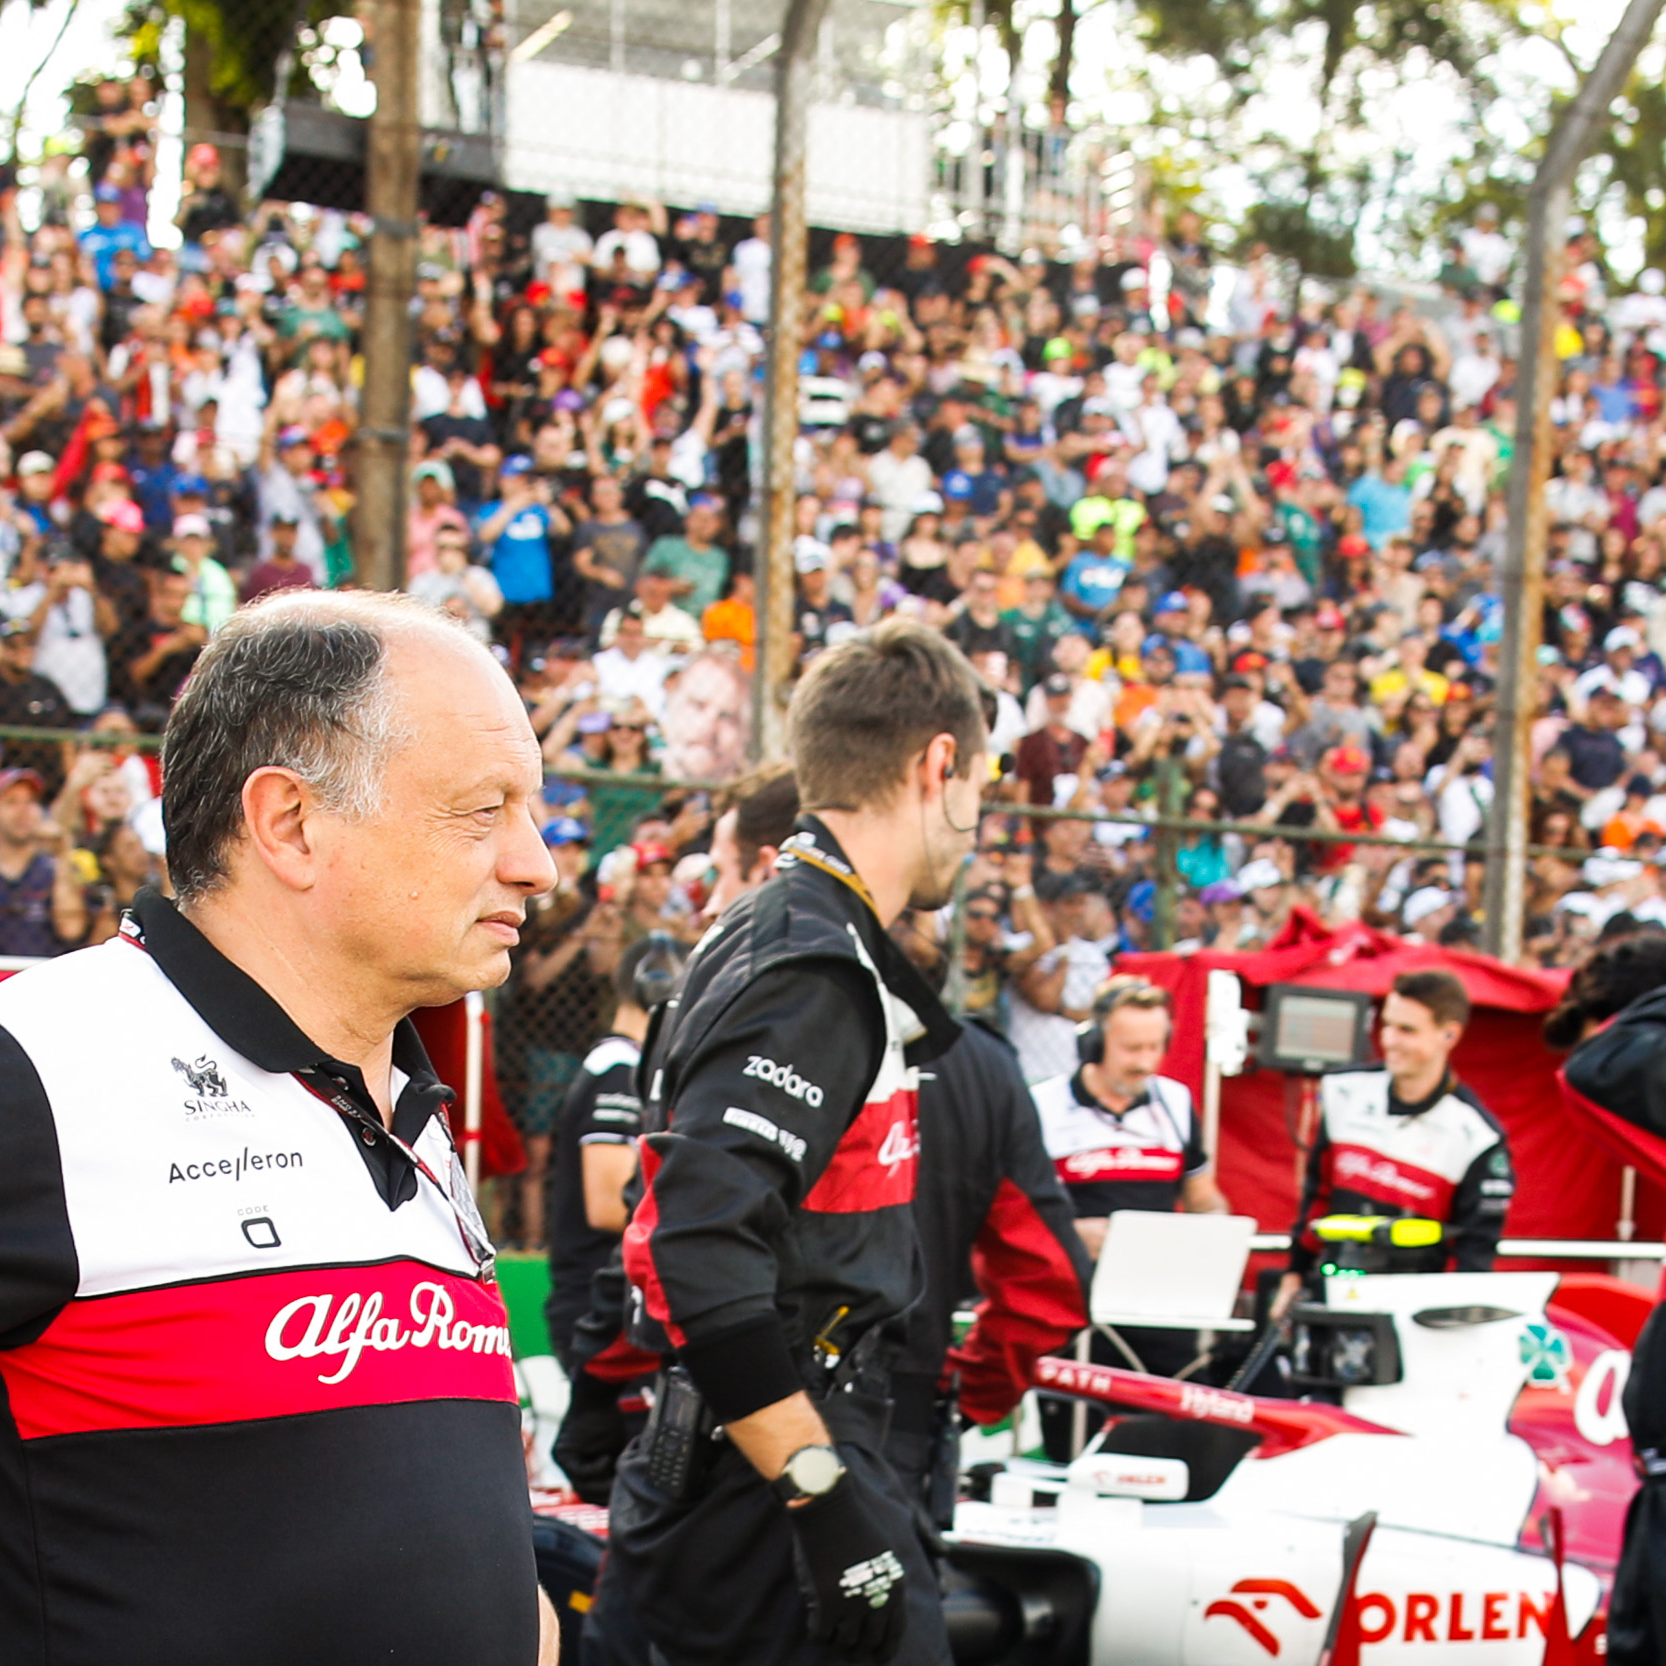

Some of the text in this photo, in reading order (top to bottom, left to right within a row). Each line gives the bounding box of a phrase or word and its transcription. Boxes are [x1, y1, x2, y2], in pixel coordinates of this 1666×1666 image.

[184, 1100, 252, 1116] SINGHA
[742, 1055, 824, 1108] zadara
[237, 1205, 270, 1217] CODE
[264, 1291, 410, 1385] Alfa
[1357, 1592, 1559, 1645] ORLEN
